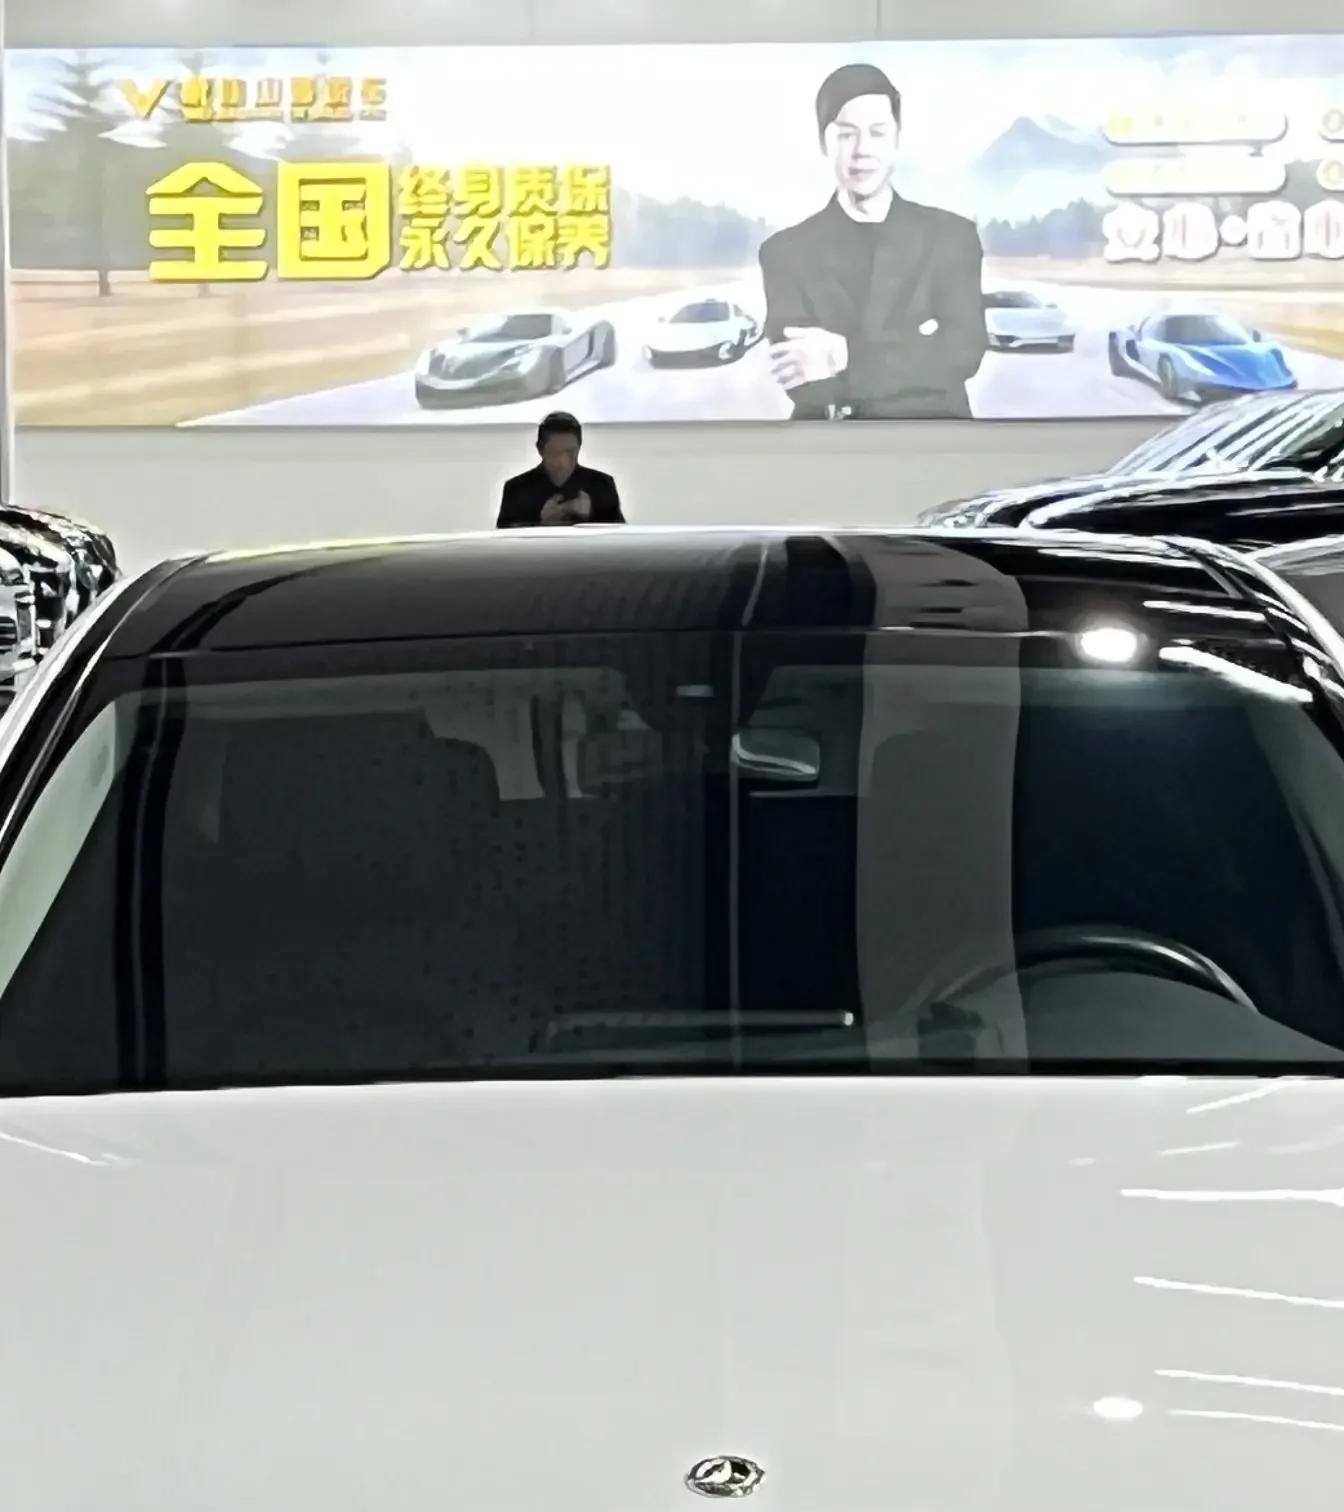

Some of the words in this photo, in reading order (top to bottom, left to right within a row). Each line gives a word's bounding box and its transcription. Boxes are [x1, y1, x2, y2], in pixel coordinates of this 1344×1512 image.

[146, 160, 391, 282] 全国
[399, 214, 611, 271] 永久保养
